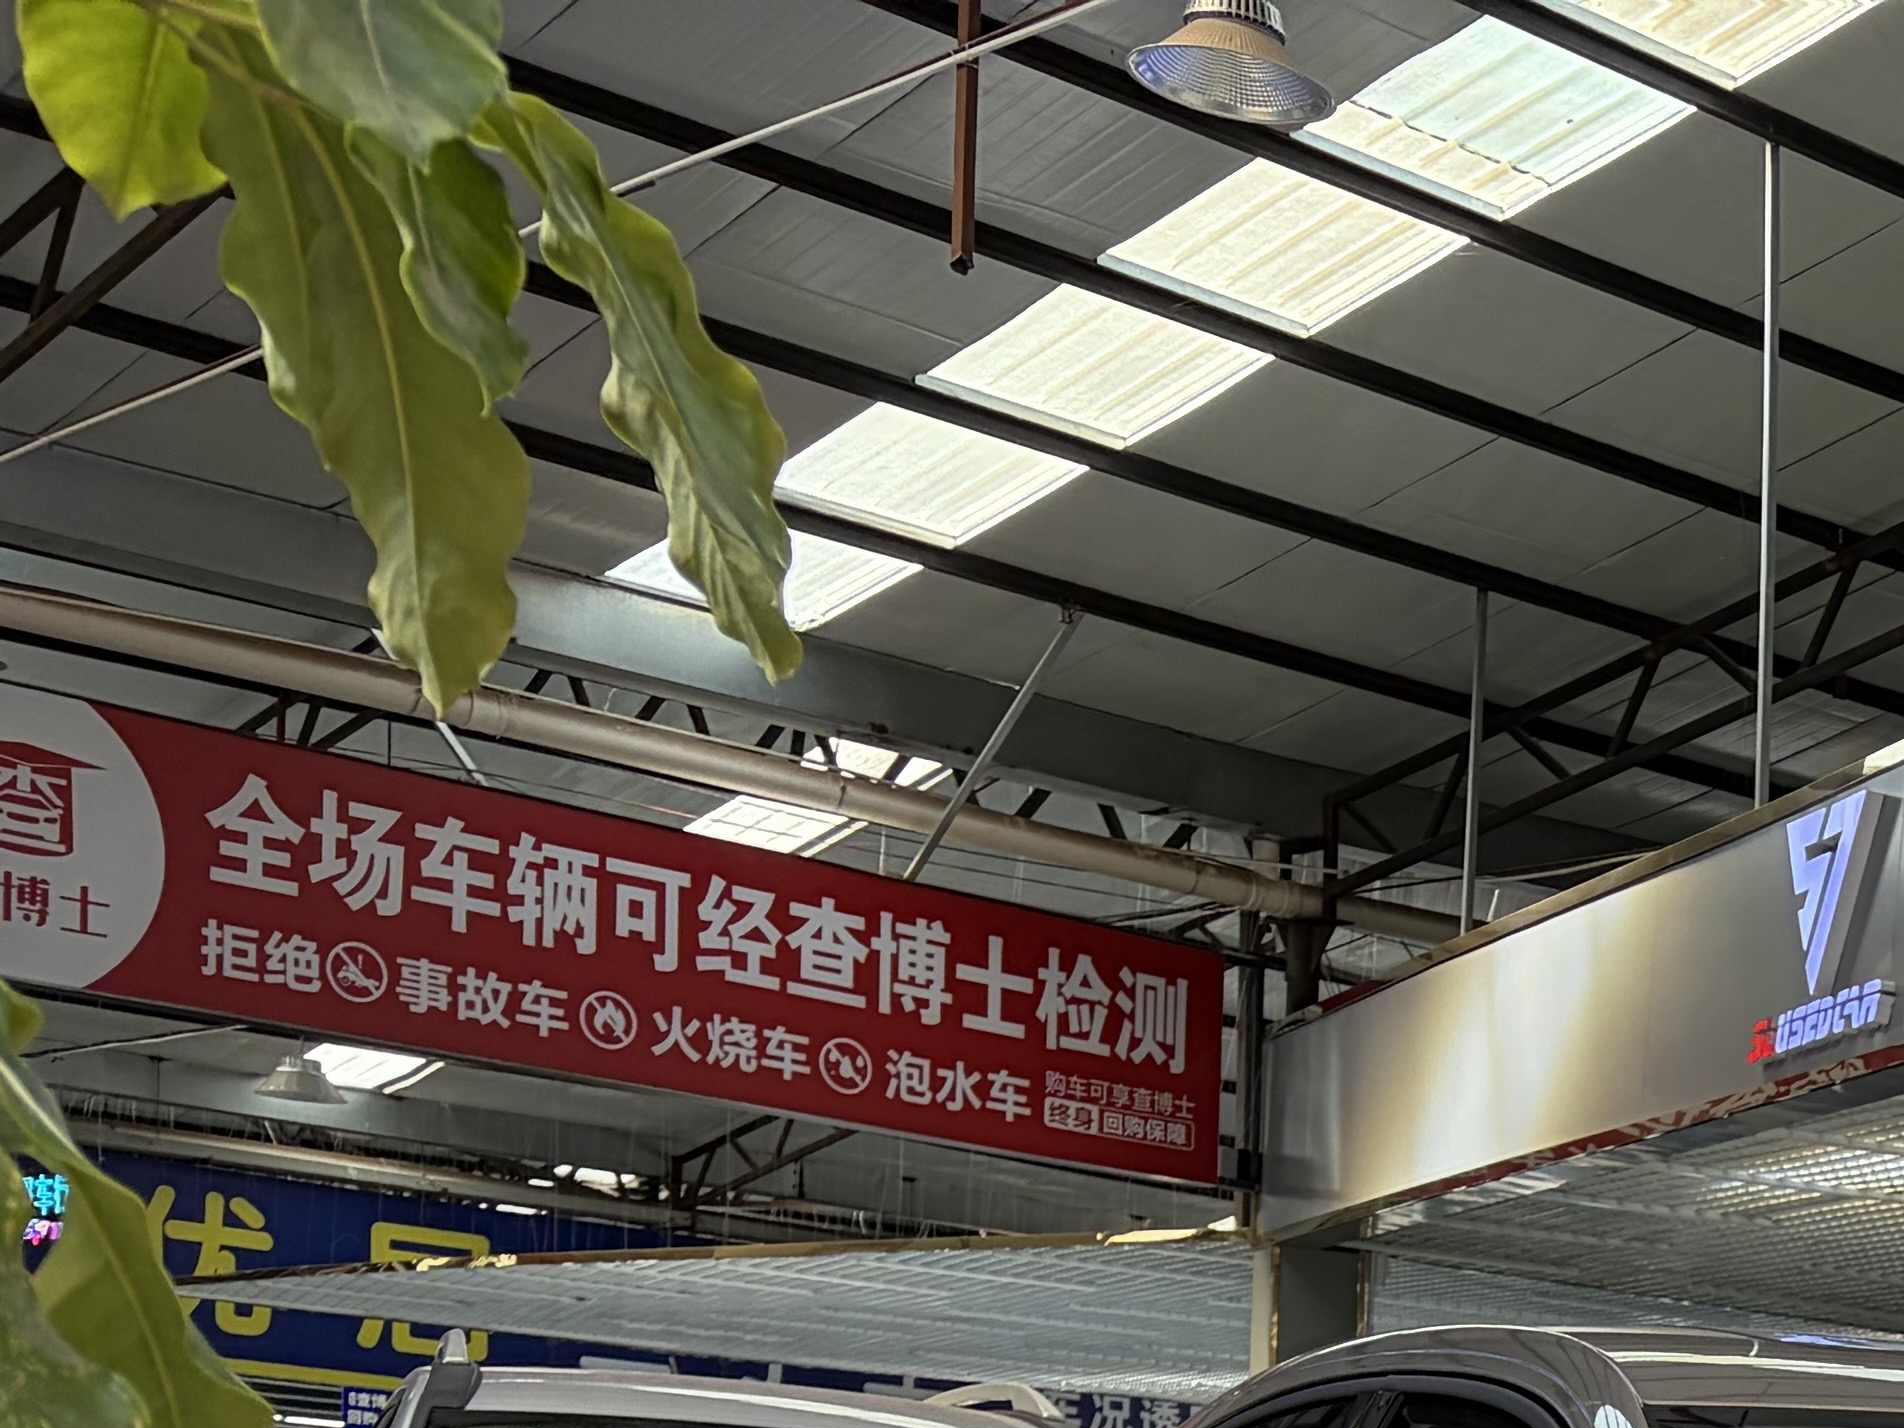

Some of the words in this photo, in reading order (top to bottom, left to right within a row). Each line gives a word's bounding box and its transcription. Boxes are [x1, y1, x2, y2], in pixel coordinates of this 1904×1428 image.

[204, 772, 1188, 1074] 全场车辆可经查博士检测
[200, 919, 322, 993] 拒绝
[396, 956, 569, 1038] 事故车
[650, 1006, 811, 1080] 火烧车
[885, 1048, 1032, 1122] 泡水车
[1045, 1070, 1195, 1119] 购车可享查博士
[1103, 1111, 1188, 1145] 回购保障
